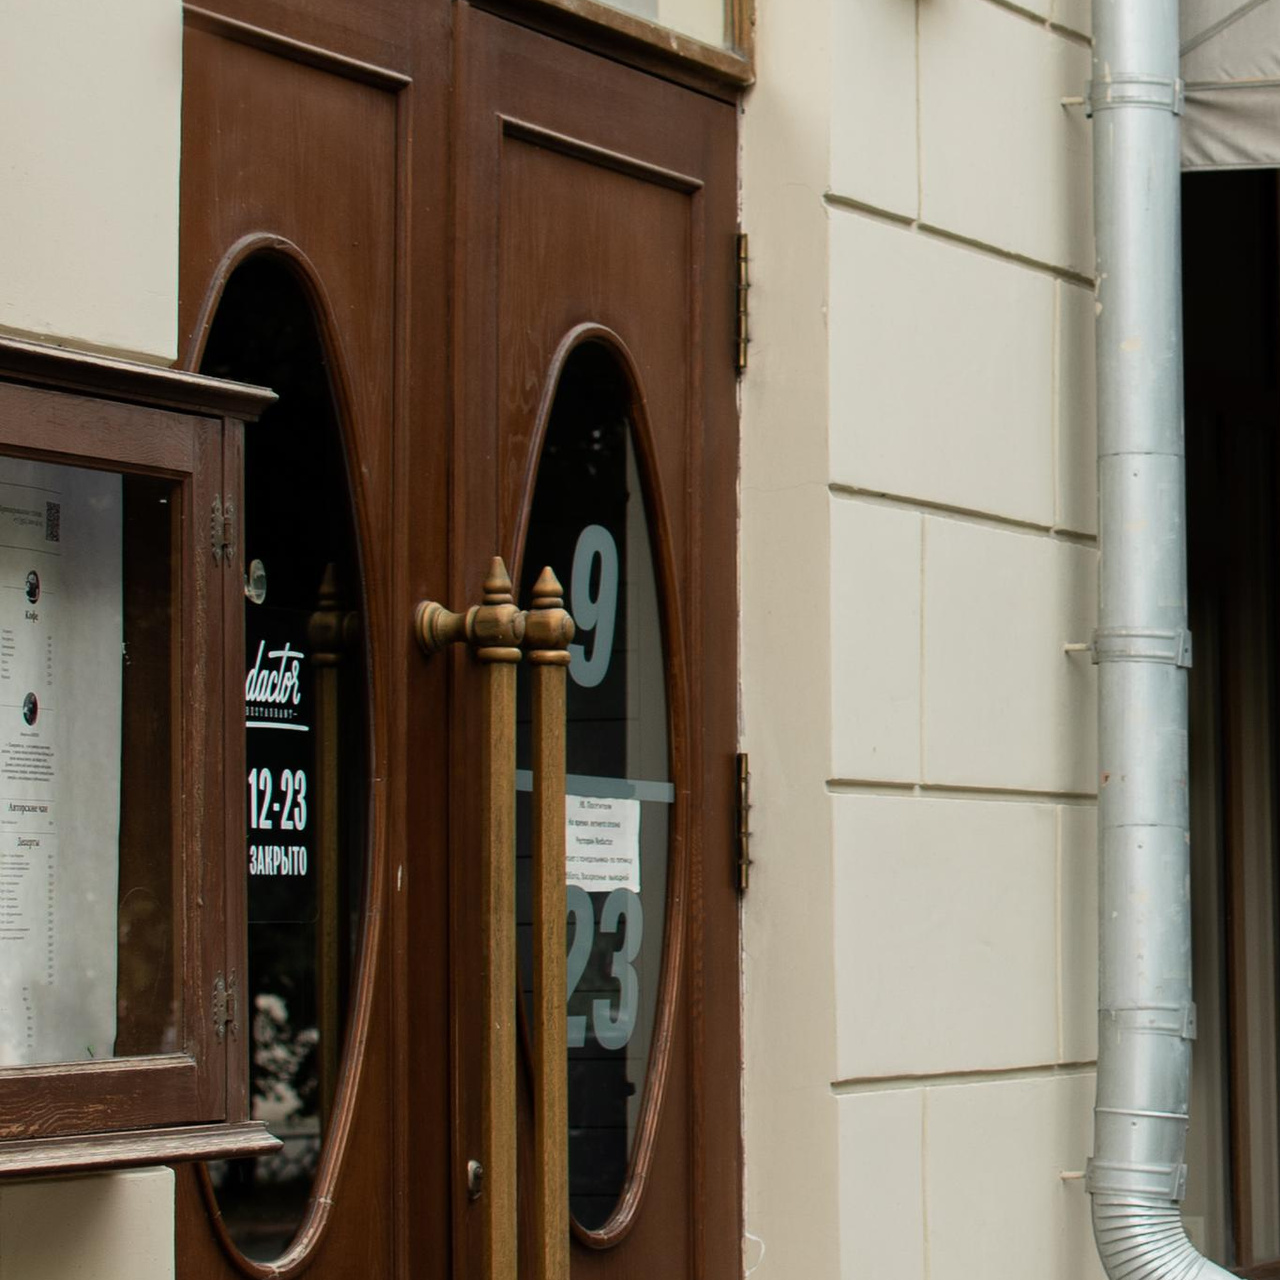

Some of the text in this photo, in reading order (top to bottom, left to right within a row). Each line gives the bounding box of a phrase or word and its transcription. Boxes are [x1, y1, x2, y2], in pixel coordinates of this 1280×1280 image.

[567, 524, 619, 688] 9
[245, 640, 304, 705] dactor
[249, 845, 308, 876] ЗАКРЫТО
